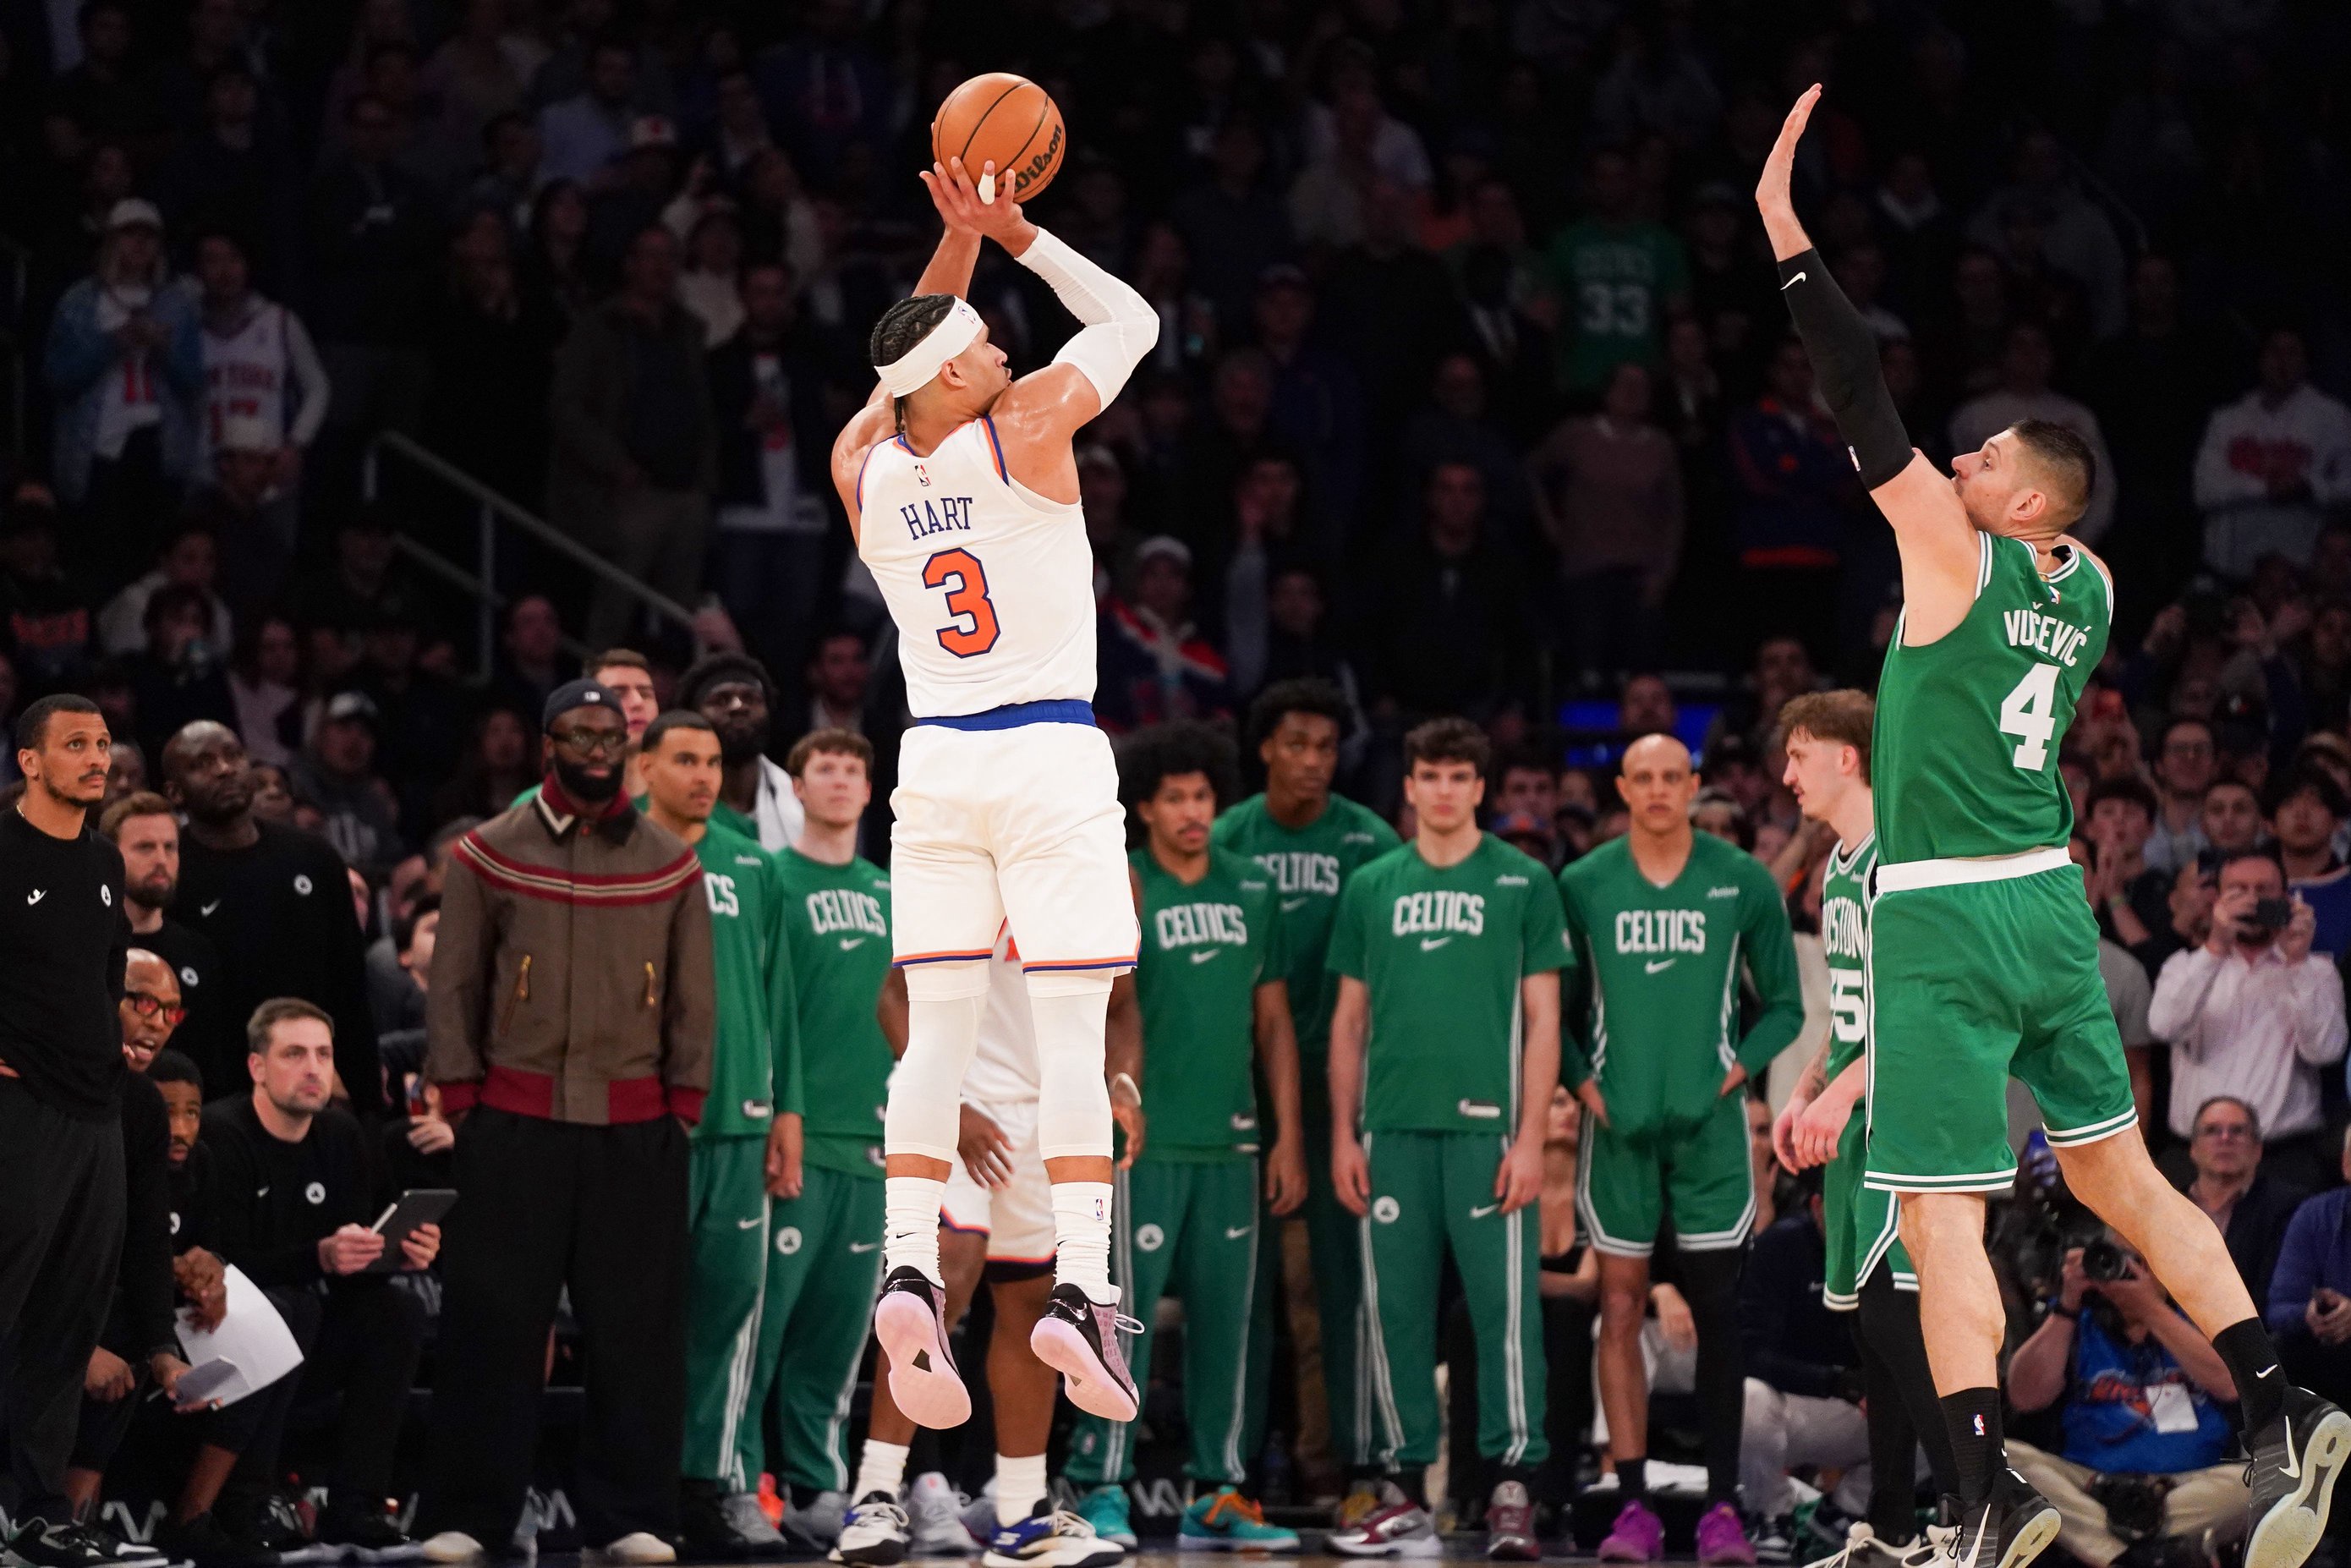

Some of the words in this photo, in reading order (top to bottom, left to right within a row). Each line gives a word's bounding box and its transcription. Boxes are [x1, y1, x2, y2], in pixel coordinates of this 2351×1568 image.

[900, 496, 973, 540] HART
[921, 547, 1001, 659] 3
[2003, 601, 2092, 667] VUČEVIĆ
[1999, 662, 2061, 772] 4
[806, 889, 887, 938] CELTICS
[1154, 902, 1247, 950] CELTICS
[1392, 890, 1486, 938] CELTICS
[1615, 908, 1707, 955] CELTICS
[1822, 896, 1864, 960] OSTON
